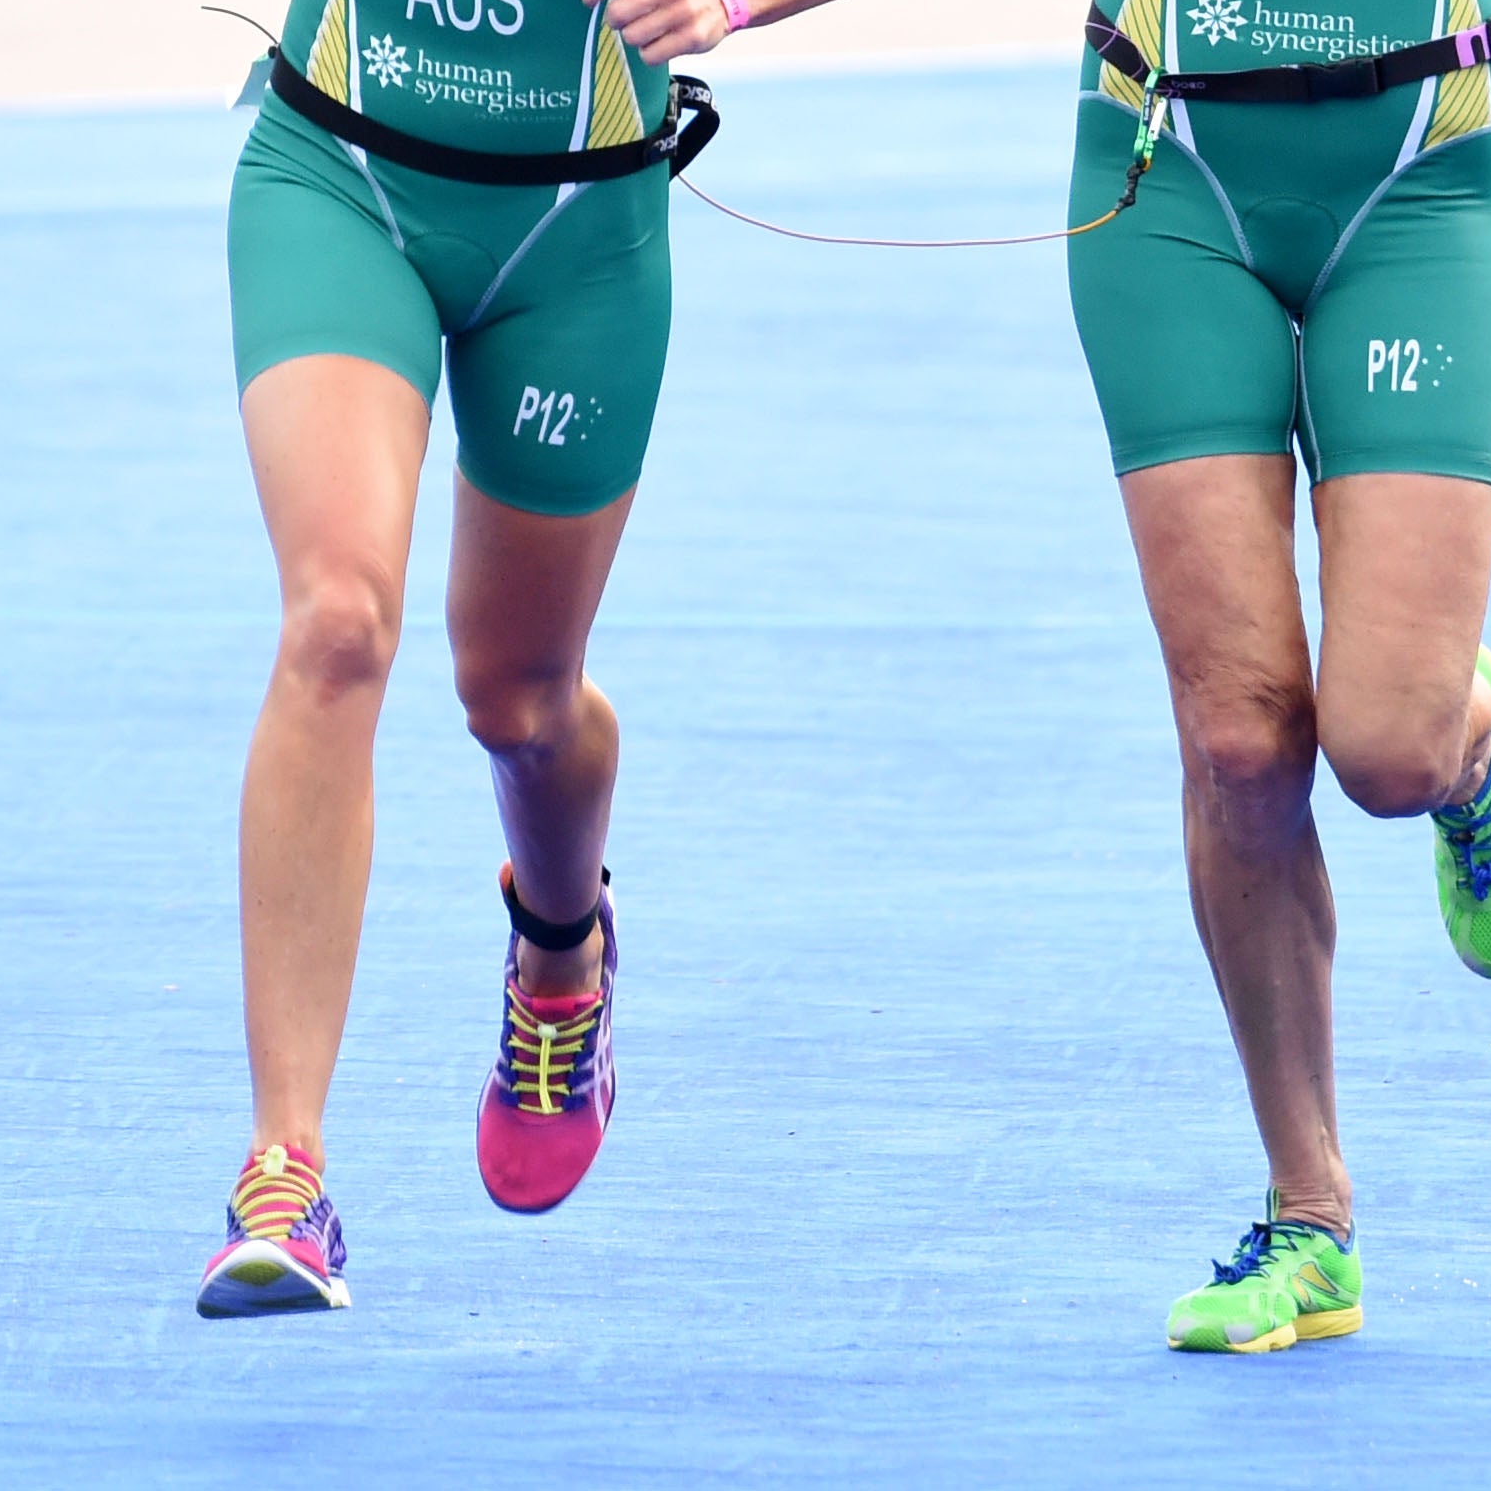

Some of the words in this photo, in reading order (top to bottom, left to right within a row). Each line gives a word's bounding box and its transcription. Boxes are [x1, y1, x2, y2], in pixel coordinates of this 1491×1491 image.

[1253, 0, 1356, 34] human
[416, 48, 512, 88] human
[413, 78, 573, 115] synergistics
[1367, 338, 1421, 393] P12
[512, 385, 575, 446] P12
